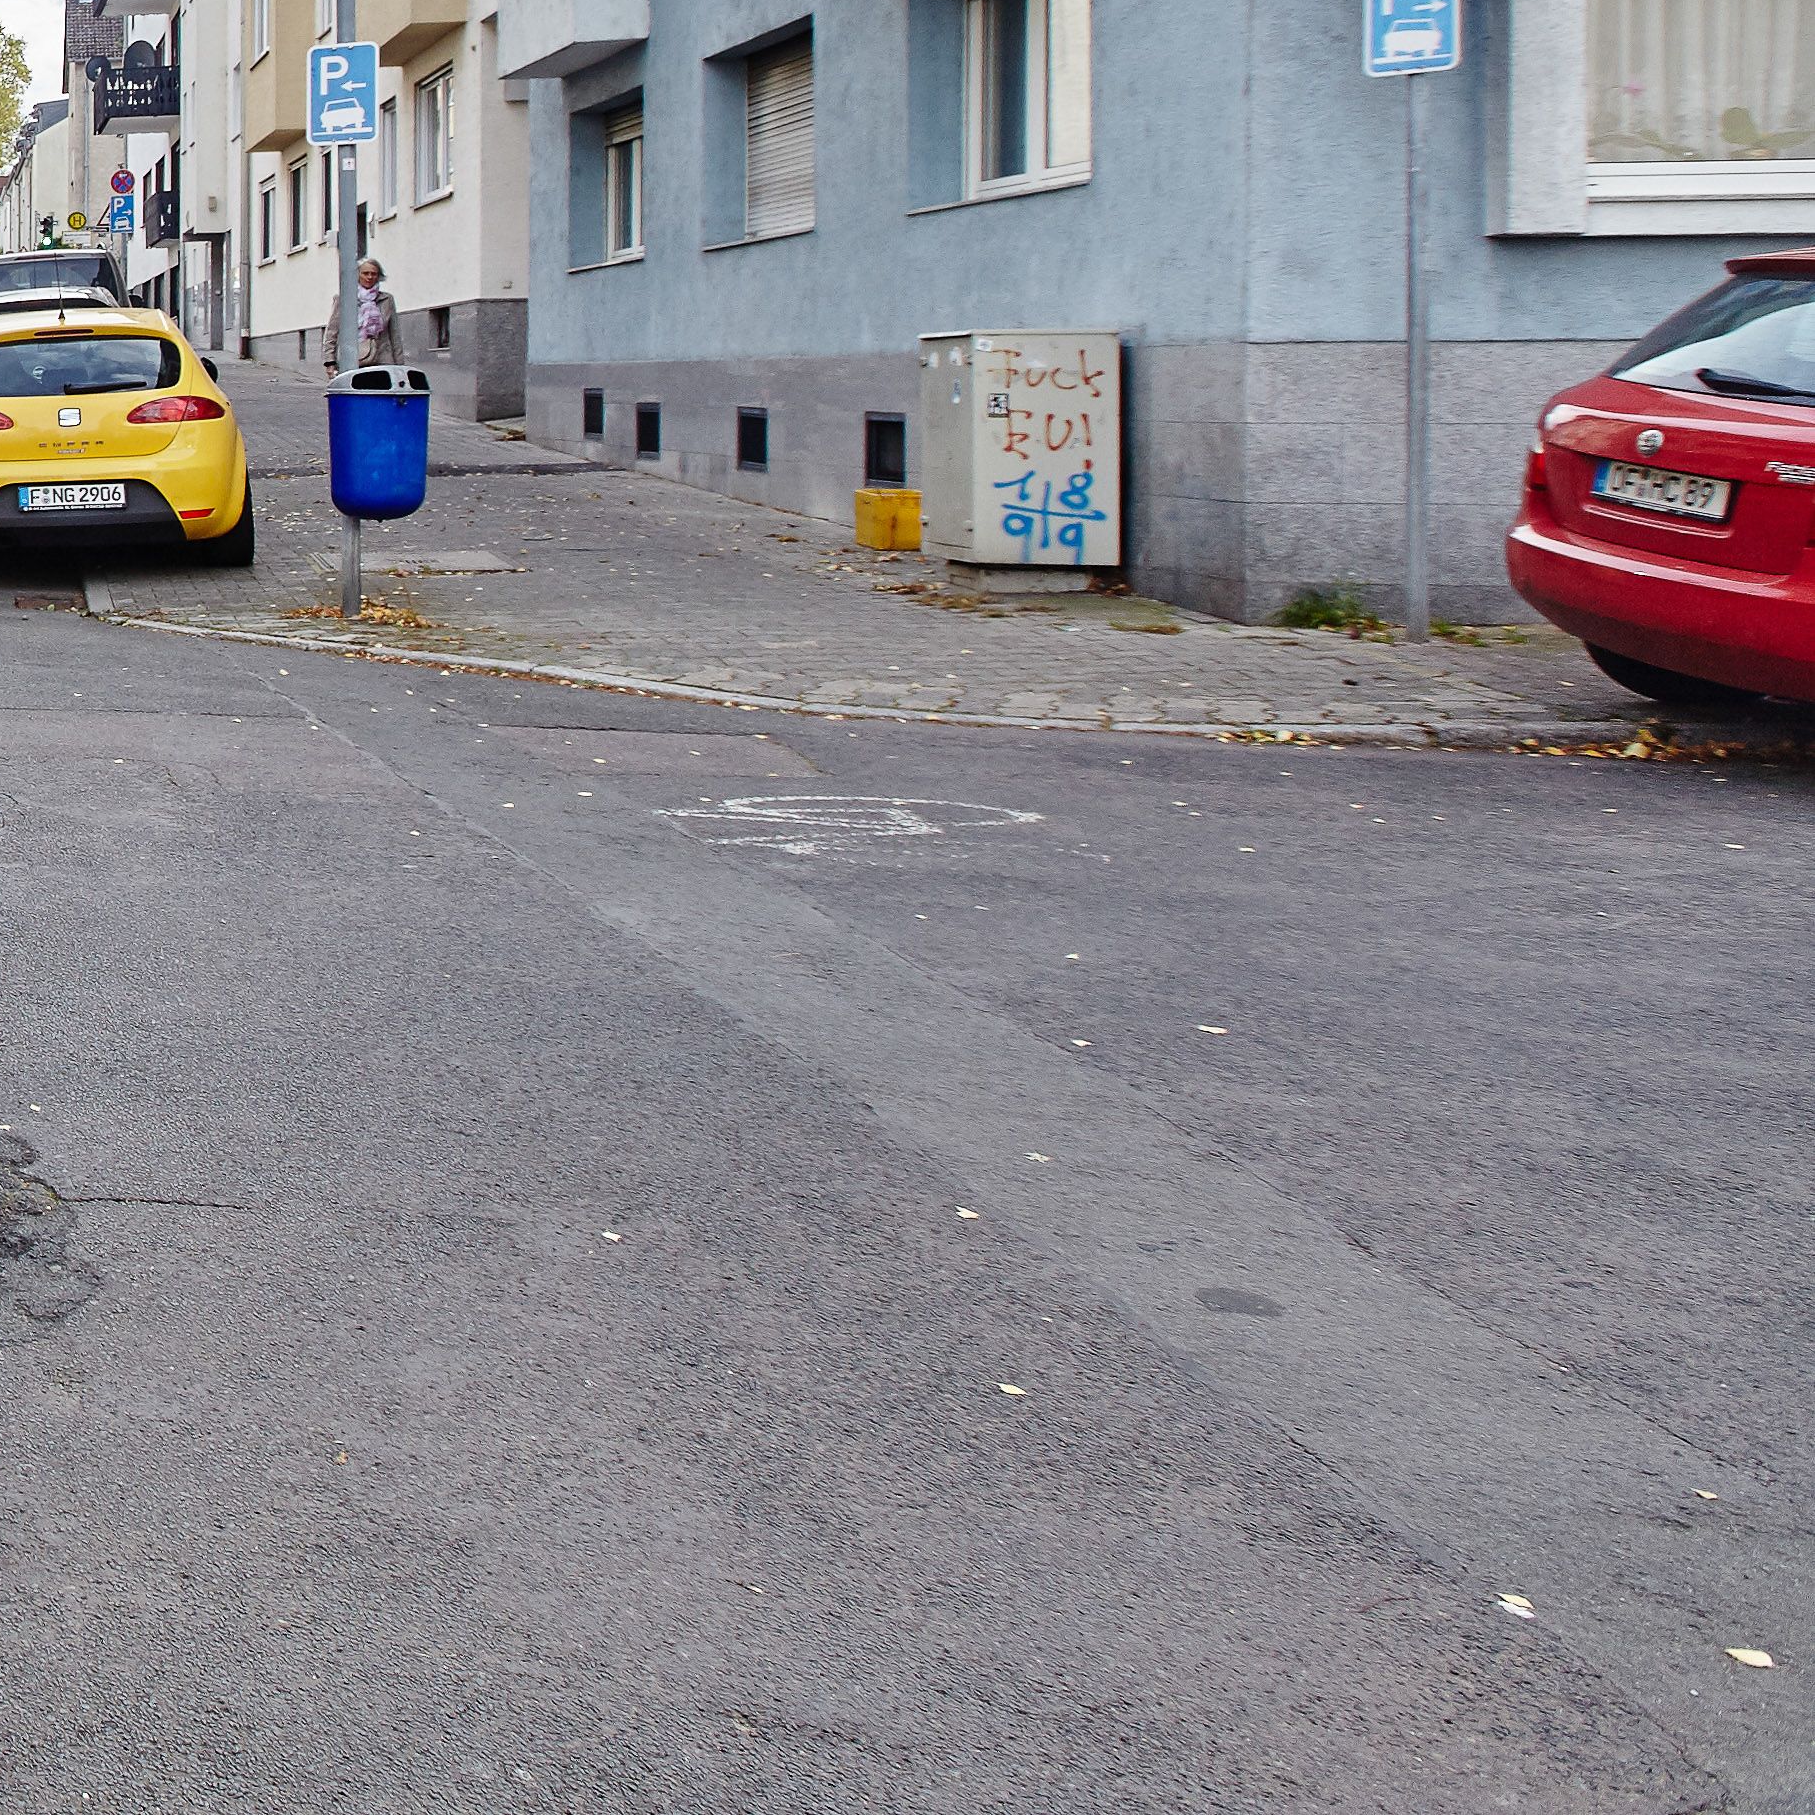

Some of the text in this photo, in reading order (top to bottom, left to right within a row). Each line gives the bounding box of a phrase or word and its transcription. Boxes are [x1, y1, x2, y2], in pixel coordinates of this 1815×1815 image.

[320, 55, 349, 95] P
[113, 197, 125, 213] P
[977, 349, 1106, 398] Fuck
[30, 486, 122, 504] F NG 2906
[1683, 477, 1716, 509] 89
